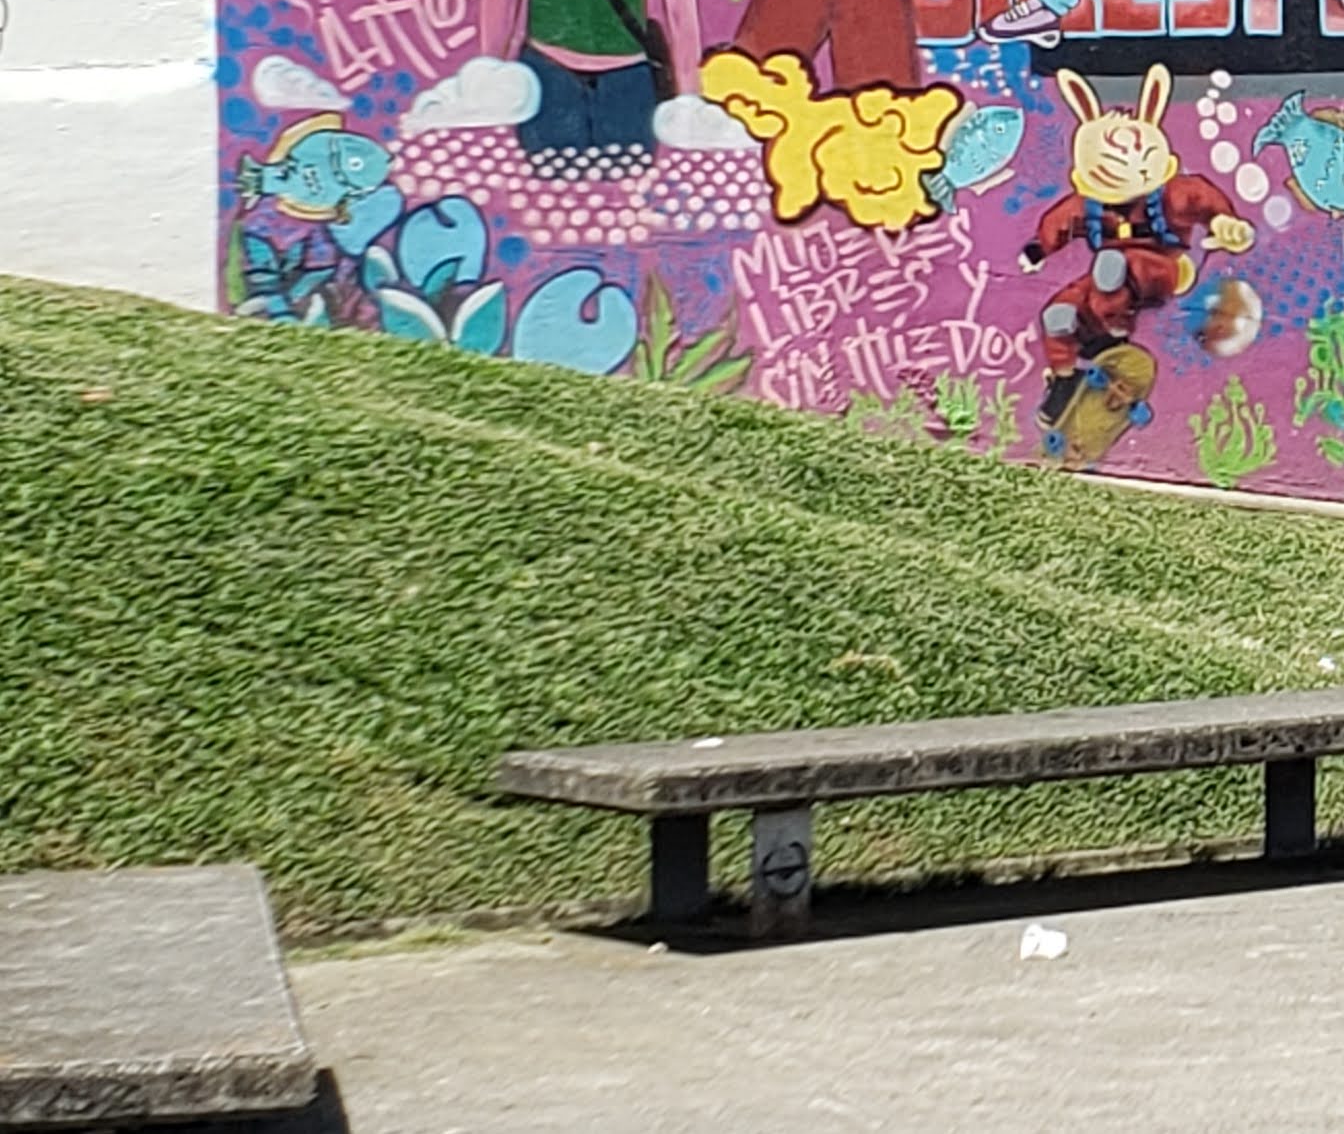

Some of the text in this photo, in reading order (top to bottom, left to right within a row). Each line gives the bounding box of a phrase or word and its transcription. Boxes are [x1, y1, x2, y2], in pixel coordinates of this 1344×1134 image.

[732, 207, 973, 299] MUJERES
[750, 254, 990, 359] LIBRES Y
